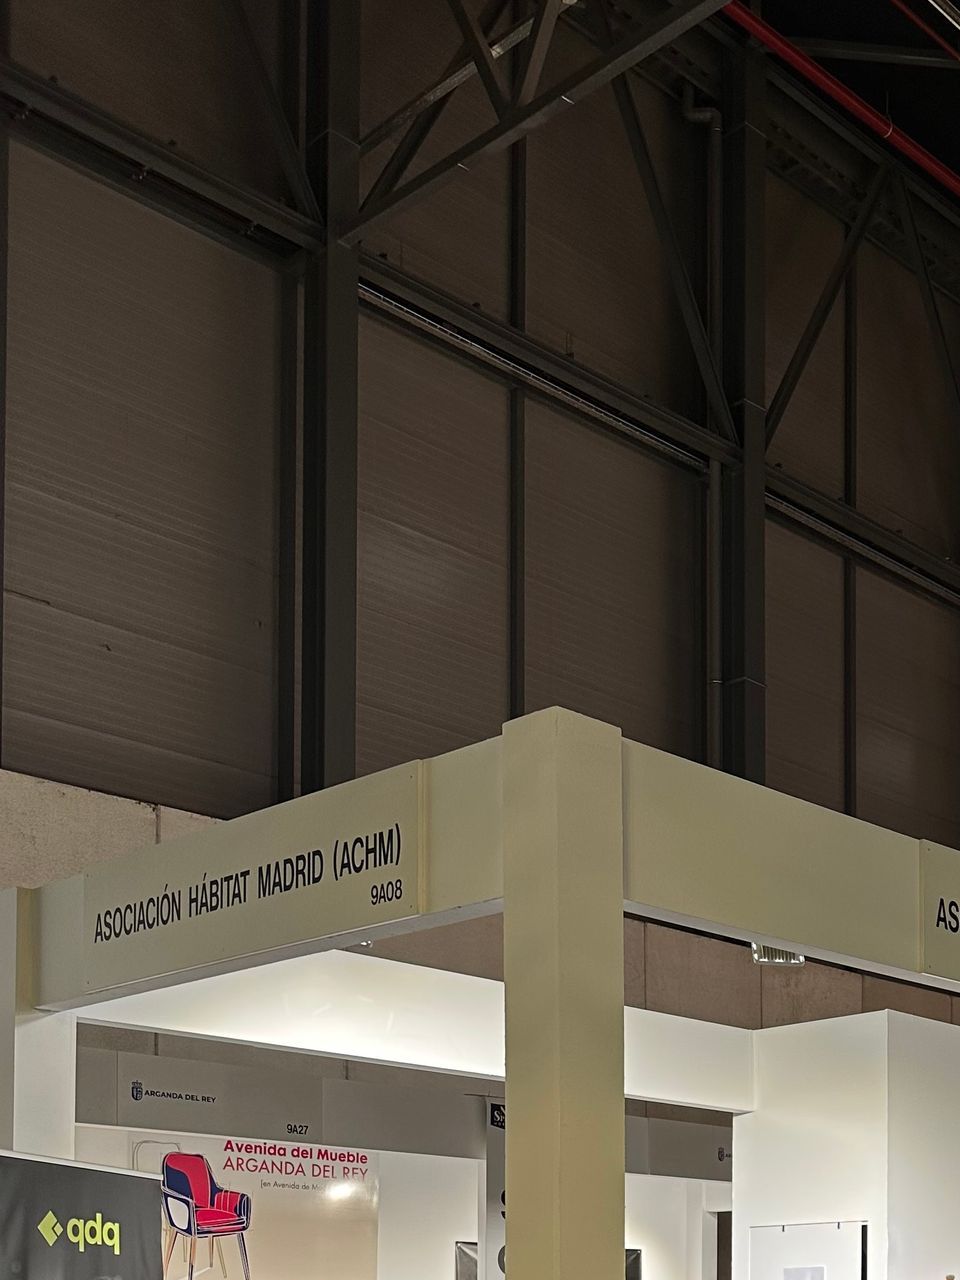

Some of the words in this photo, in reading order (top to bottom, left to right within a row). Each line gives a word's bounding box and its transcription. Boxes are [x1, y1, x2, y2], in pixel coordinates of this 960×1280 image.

[95, 884, 181, 943] ASOCIACIÓN
[188, 872, 250, 918] HÁBITAT
[257, 849, 324, 899] MADRID
[332, 822, 402, 881] (ACHM)
[370, 879, 403, 906] 9A08
[144, 1089, 183, 1100] ARGANDA
[184, 1093, 200, 1102] DEL
[201, 1095, 216, 1103] REY
[286, 1123, 309, 1135] 9A27
[223, 1139, 287, 1157] Avenida
[291, 1146, 313, 1160] del
[317, 1149, 368, 1164] Mueble
[222, 1156, 306, 1177] ARGANDA
[312, 1163, 337, 1179] DEL
[273, 1181, 300, 1190] Avenida
[66, 1212, 120, 1255] qdq
